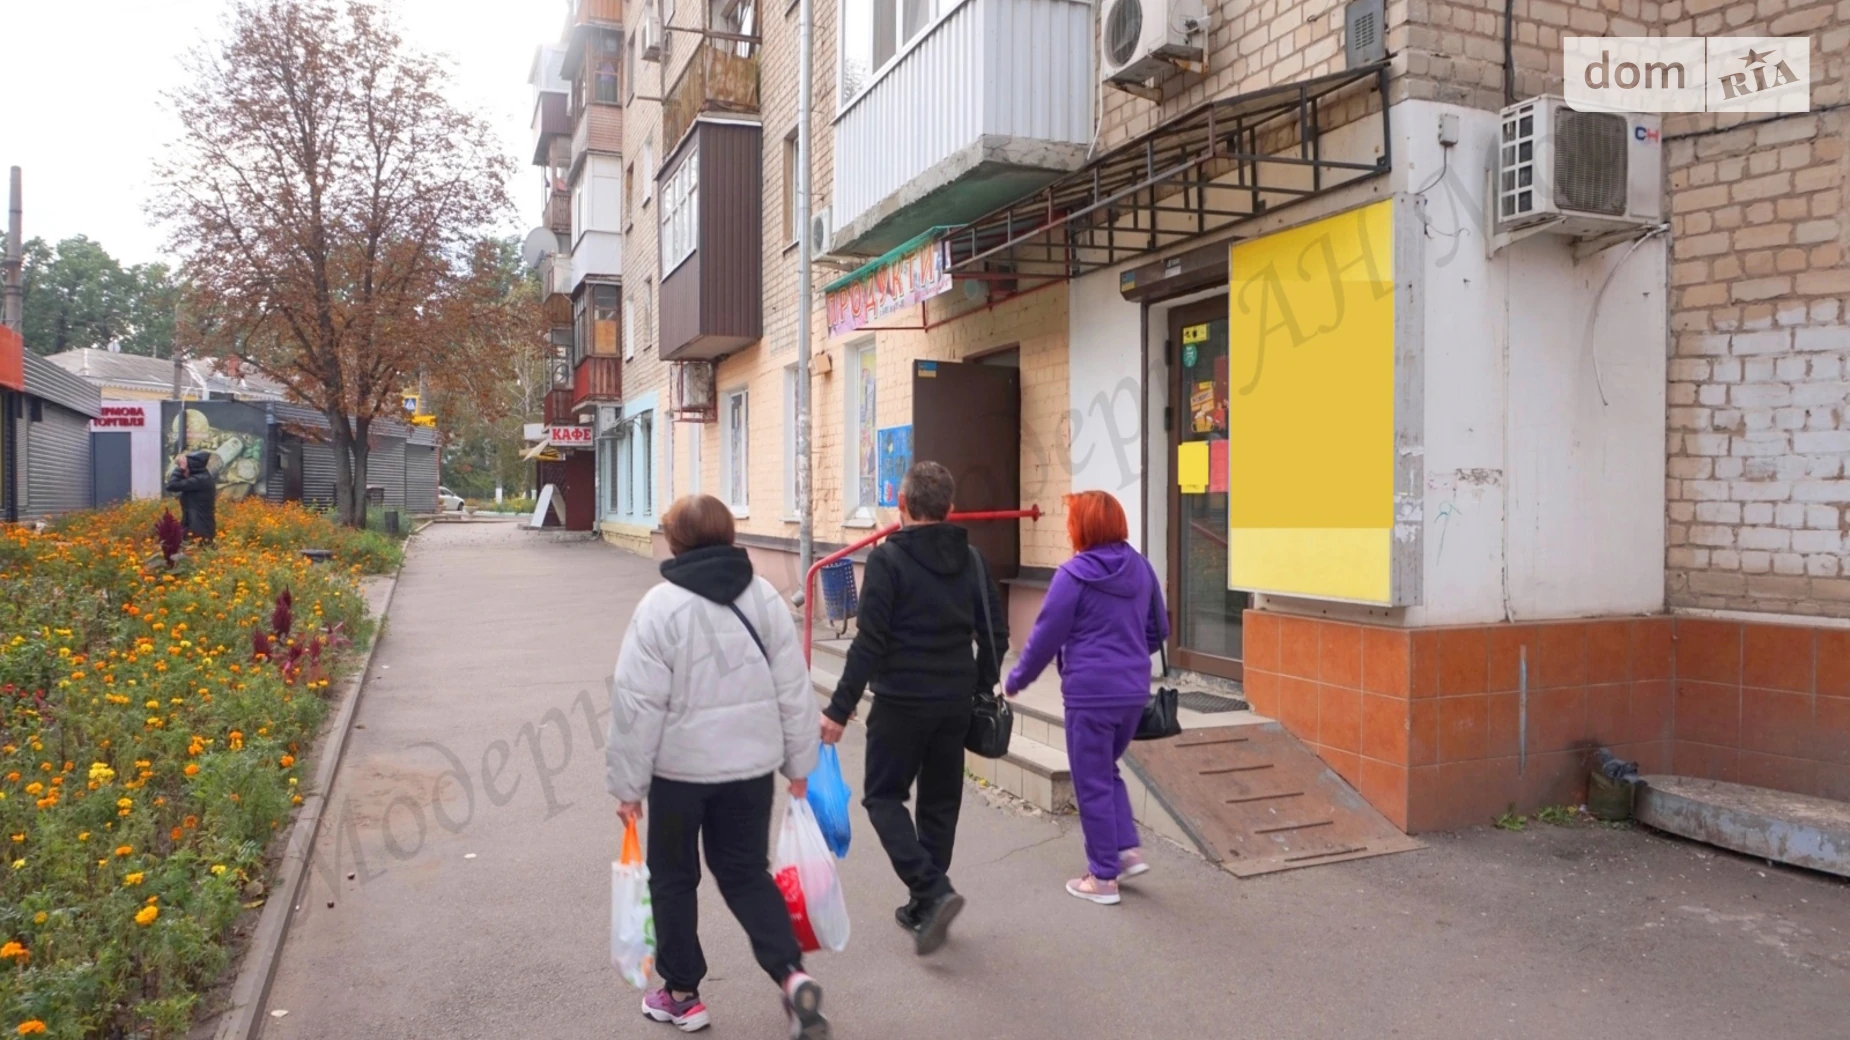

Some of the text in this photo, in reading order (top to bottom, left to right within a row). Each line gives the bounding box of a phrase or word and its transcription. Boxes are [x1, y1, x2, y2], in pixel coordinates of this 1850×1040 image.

[1635, 126, 1659, 144] CH
[827, 245, 934, 328] ПРОДУКТИ
[101, 407, 145, 416] ІРМОВА
[552, 428, 592, 440] КАФЕ
